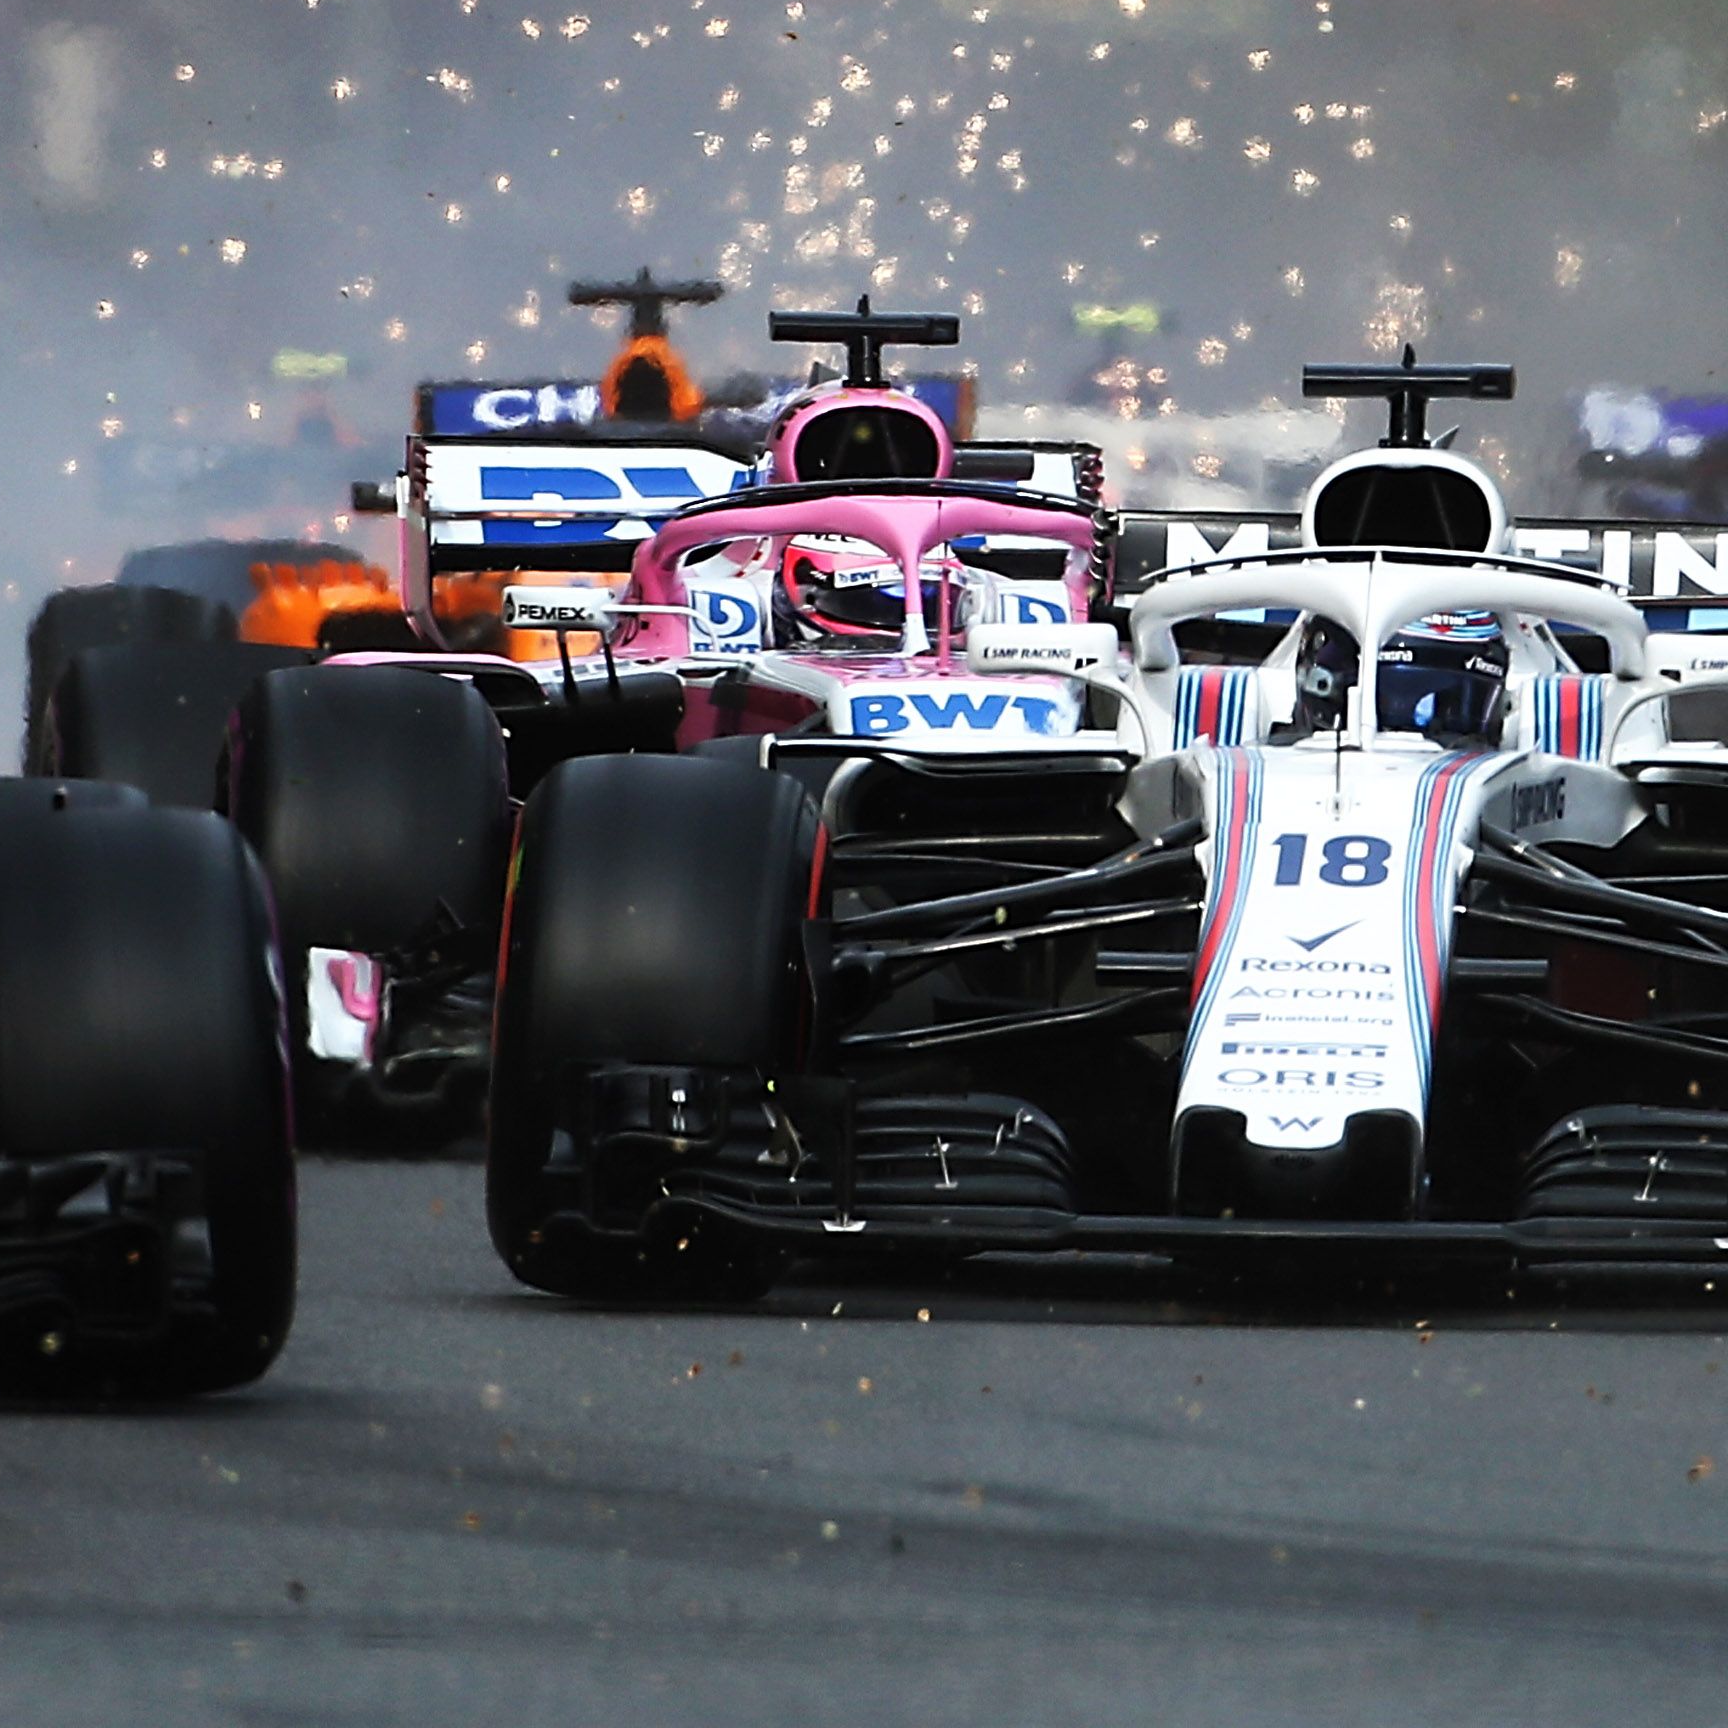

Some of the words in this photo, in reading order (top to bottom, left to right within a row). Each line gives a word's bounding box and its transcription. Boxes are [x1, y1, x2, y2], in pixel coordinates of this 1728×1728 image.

[518, 604, 586, 621] PEMEX
[991, 647, 1019, 659] SMP
[1020, 647, 1073, 660] RACING
[850, 693, 1057, 737] BWT
[1272, 832, 1393, 888] 18
[1240, 956, 1392, 975] Rexona
[1229, 985, 1395, 1001] Acronis
[1217, 1068, 1385, 1089] ORIS
